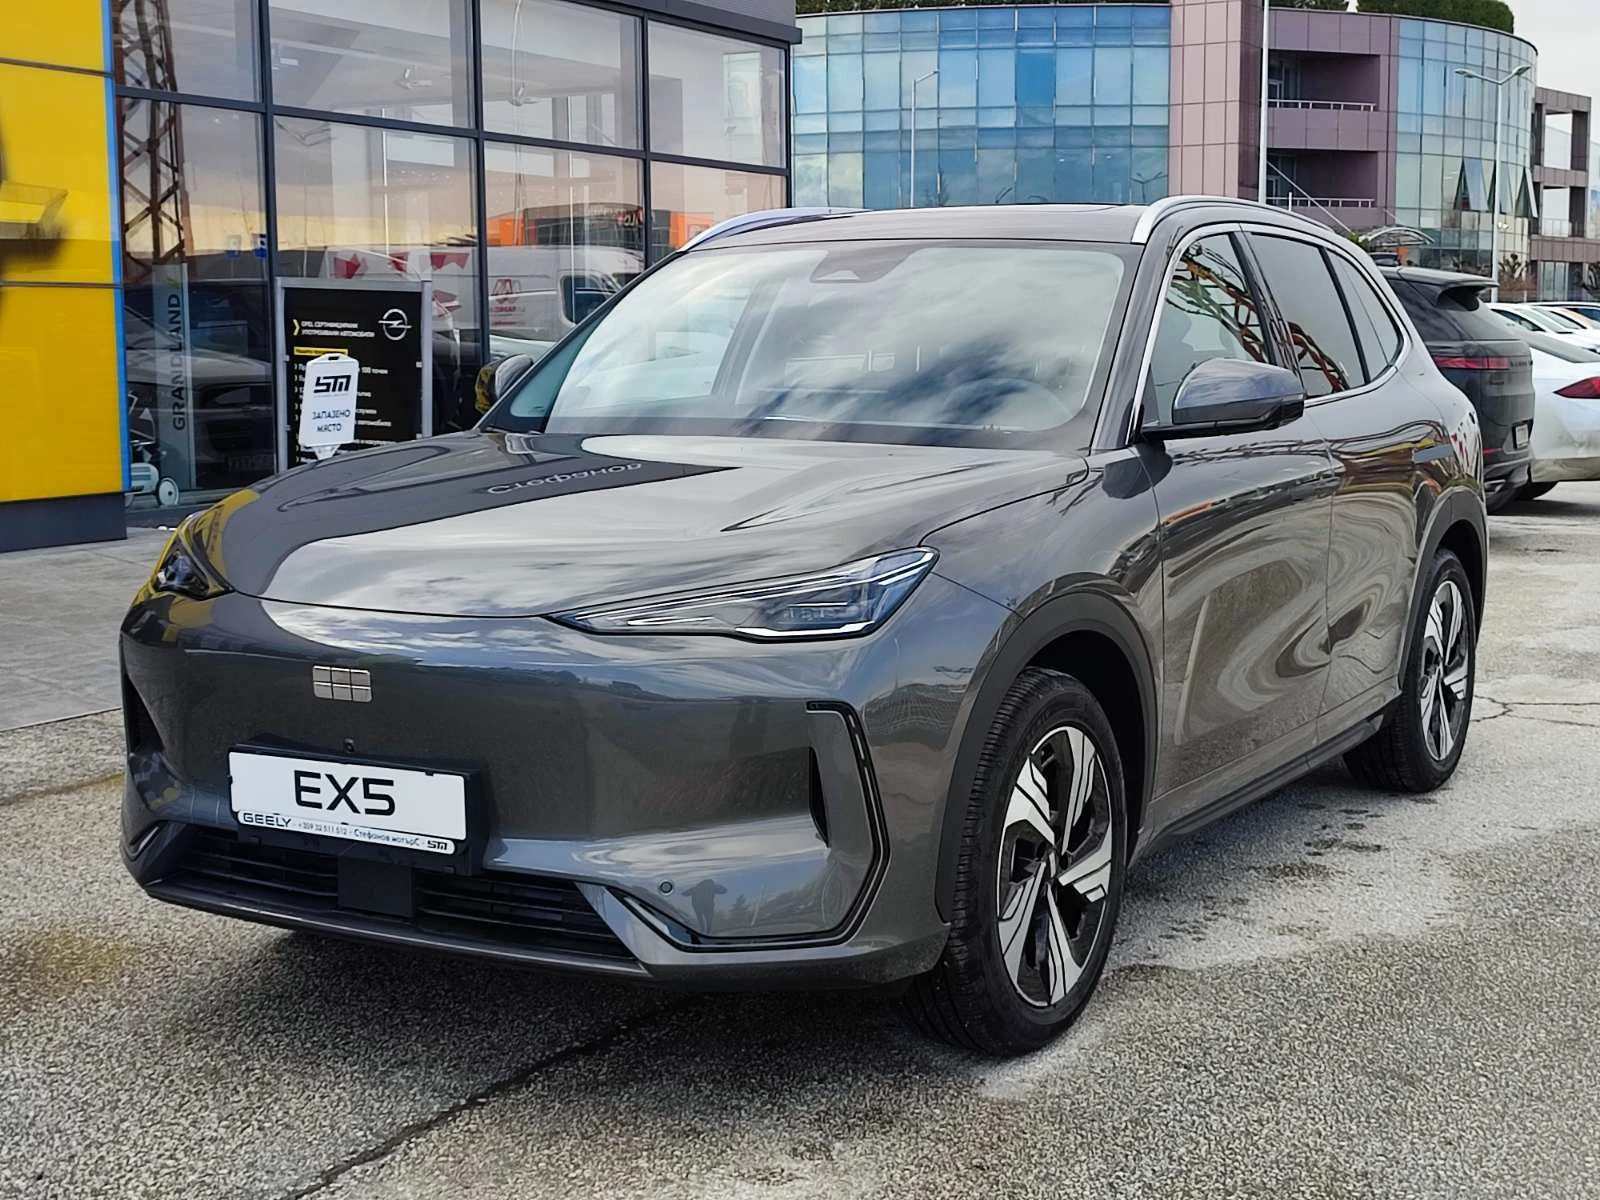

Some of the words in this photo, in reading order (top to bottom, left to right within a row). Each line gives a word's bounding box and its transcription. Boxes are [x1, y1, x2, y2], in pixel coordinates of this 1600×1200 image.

[168, 294, 186, 431] GRANDLAND
[312, 409, 351, 420] ЗАПАЗЕНО
[317, 423, 342, 432] МЯСТО
[294, 769, 396, 816] EX5
[243, 812, 292, 828] GEELY
